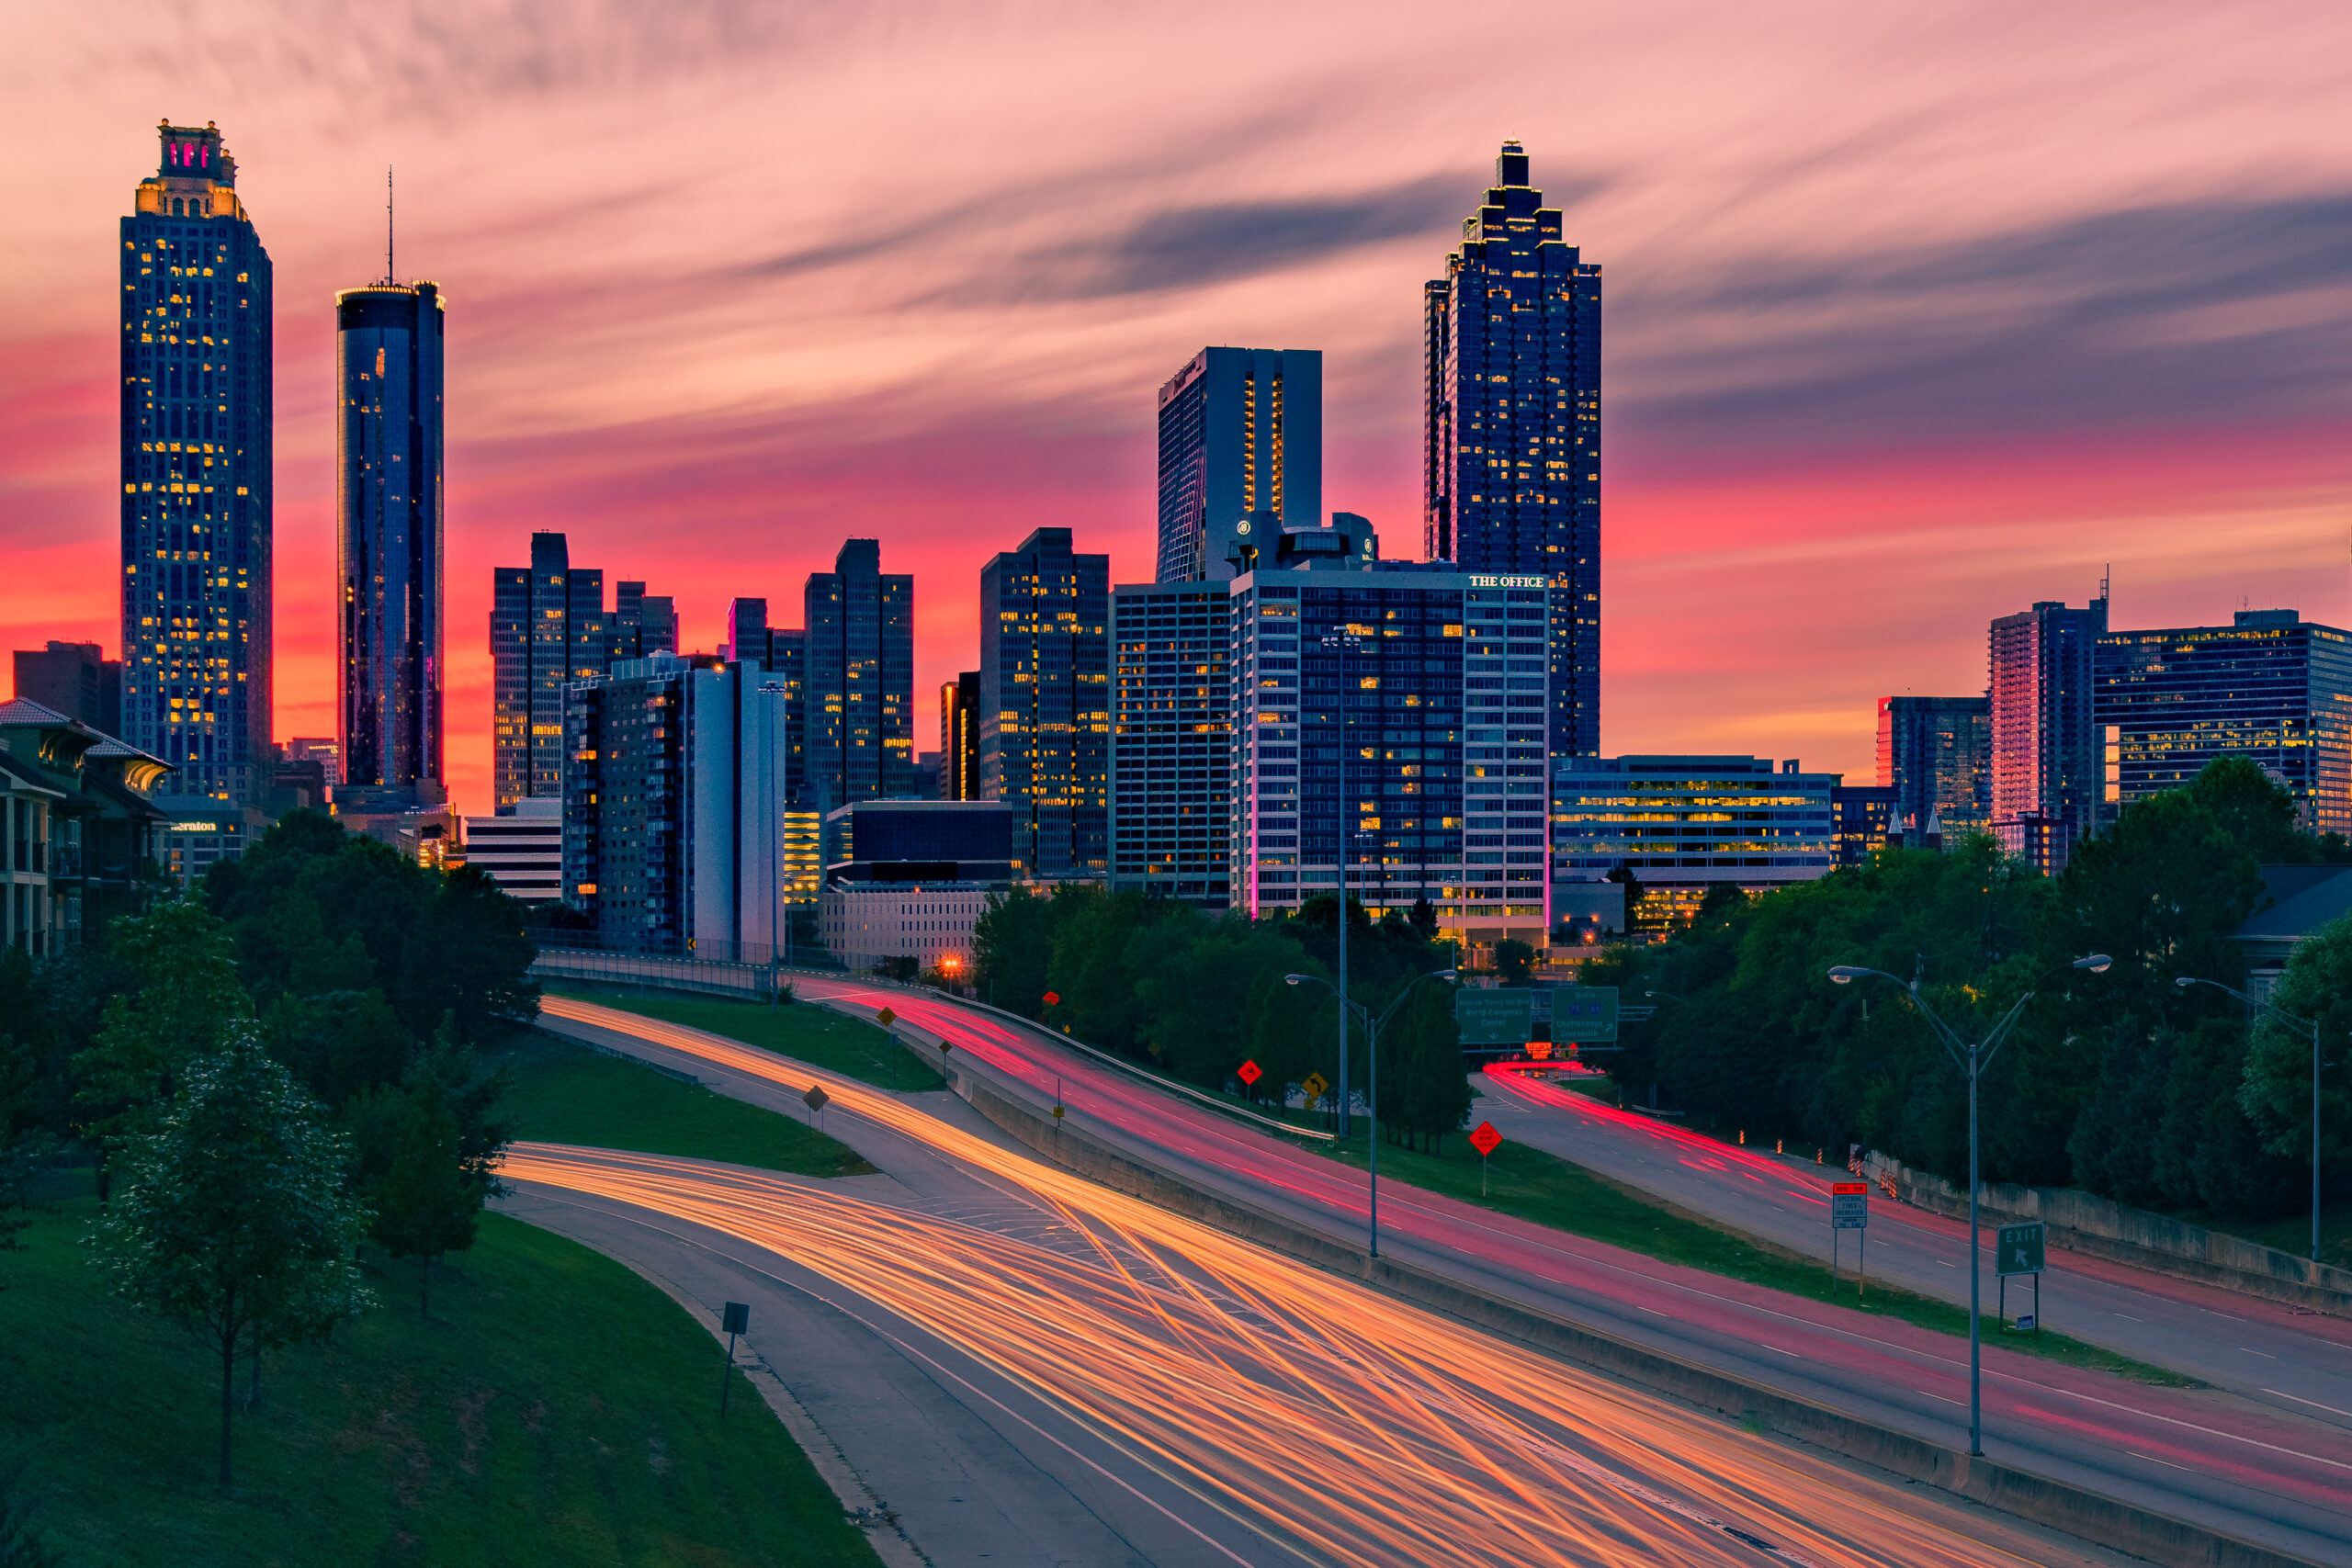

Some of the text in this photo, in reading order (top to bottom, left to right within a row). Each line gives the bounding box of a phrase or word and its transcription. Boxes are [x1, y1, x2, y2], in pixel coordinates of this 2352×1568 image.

[1469, 575, 1544, 588] THE OFFICE
[170, 821, 217, 831] eraton
[1488, 1009, 1523, 1017] Congress
[1481, 1019, 1507, 1027] Center
[1556, 1021, 1603, 1029] Chattanooga
[1560, 1029, 1598, 1037] Greenville
[2006, 1228, 2037, 1243] EXIT
